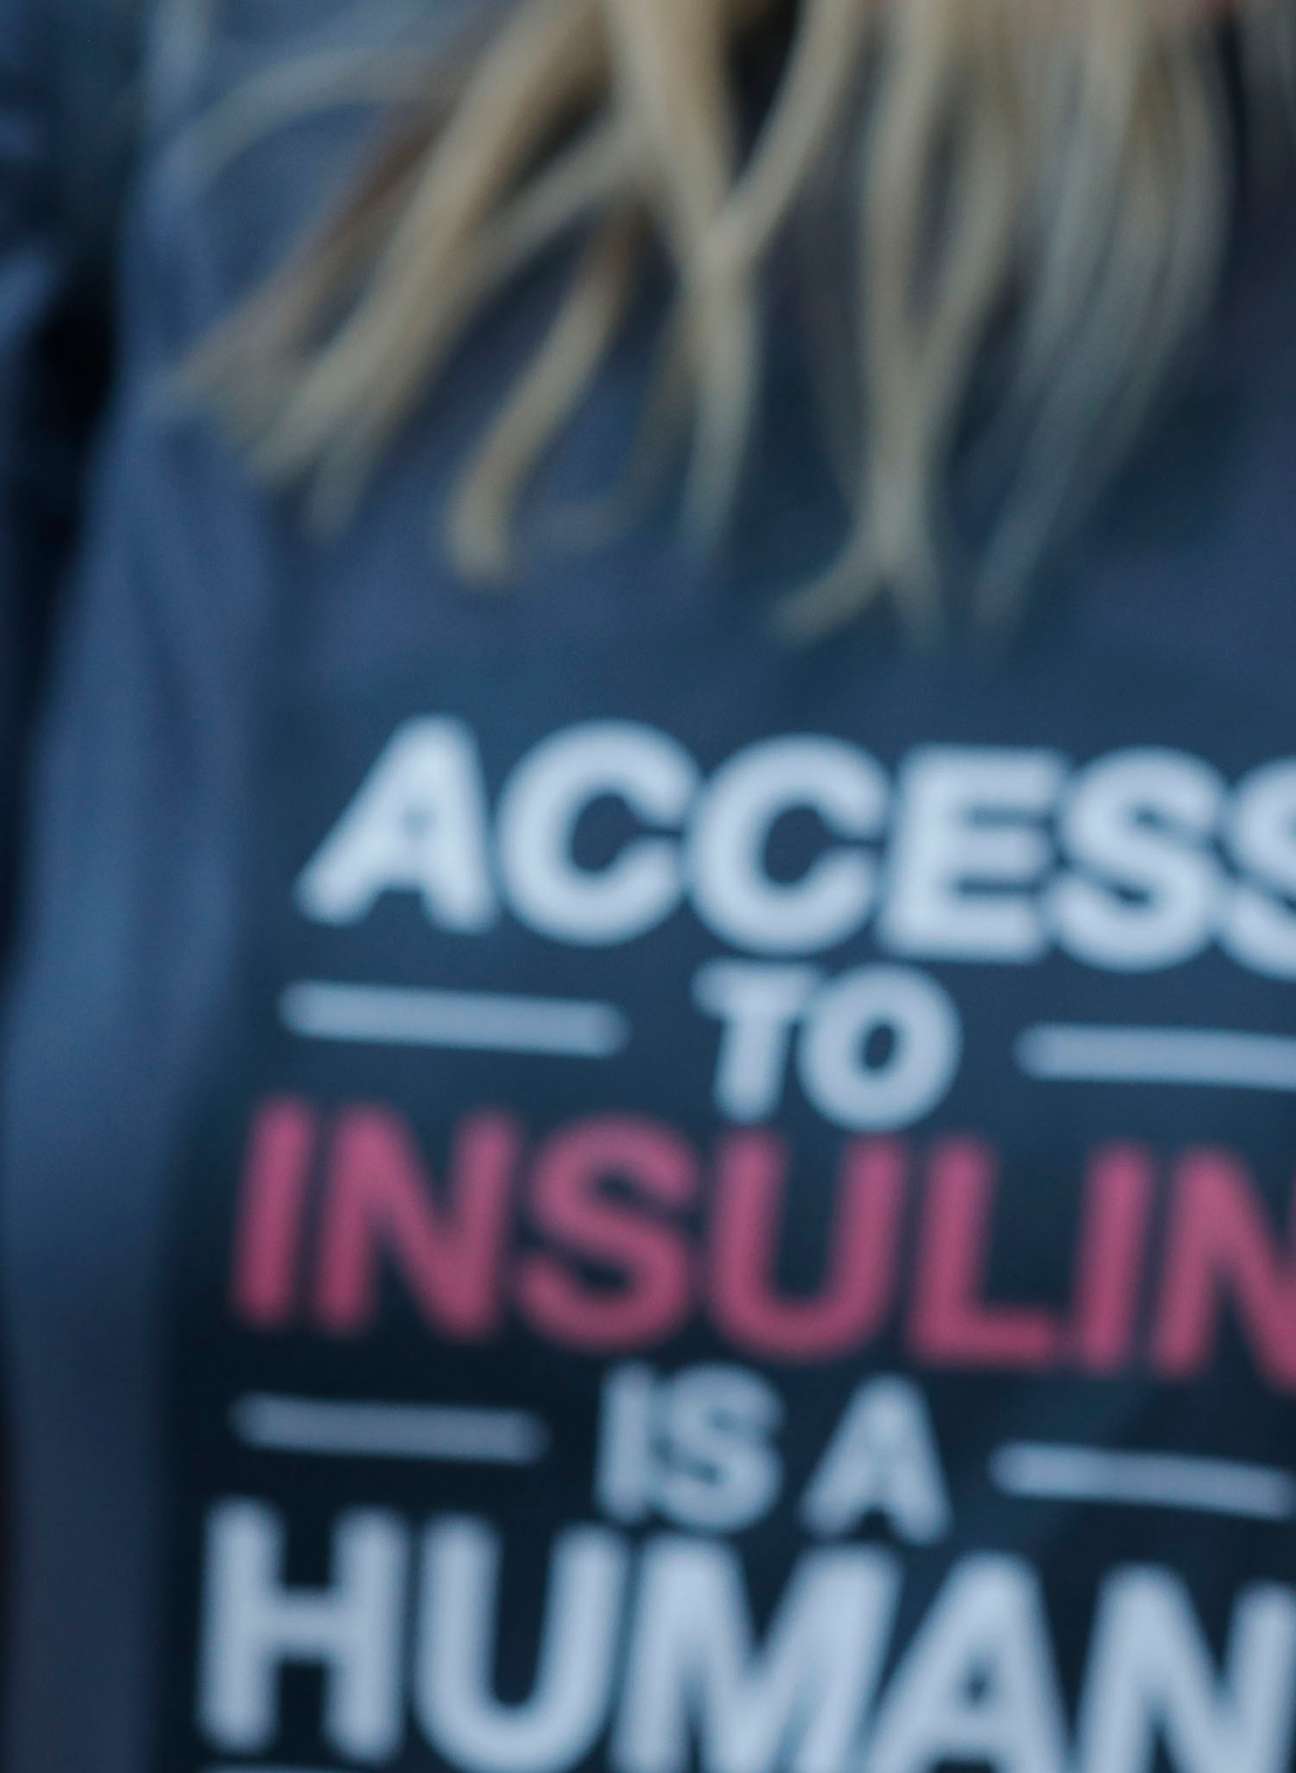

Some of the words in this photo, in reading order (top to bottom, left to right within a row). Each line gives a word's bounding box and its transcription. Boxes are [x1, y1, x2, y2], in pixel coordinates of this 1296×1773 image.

[691, 958, 962, 1131] TO
[599, 1361, 787, 1532] IS
[802, 1374, 951, 1543] A
